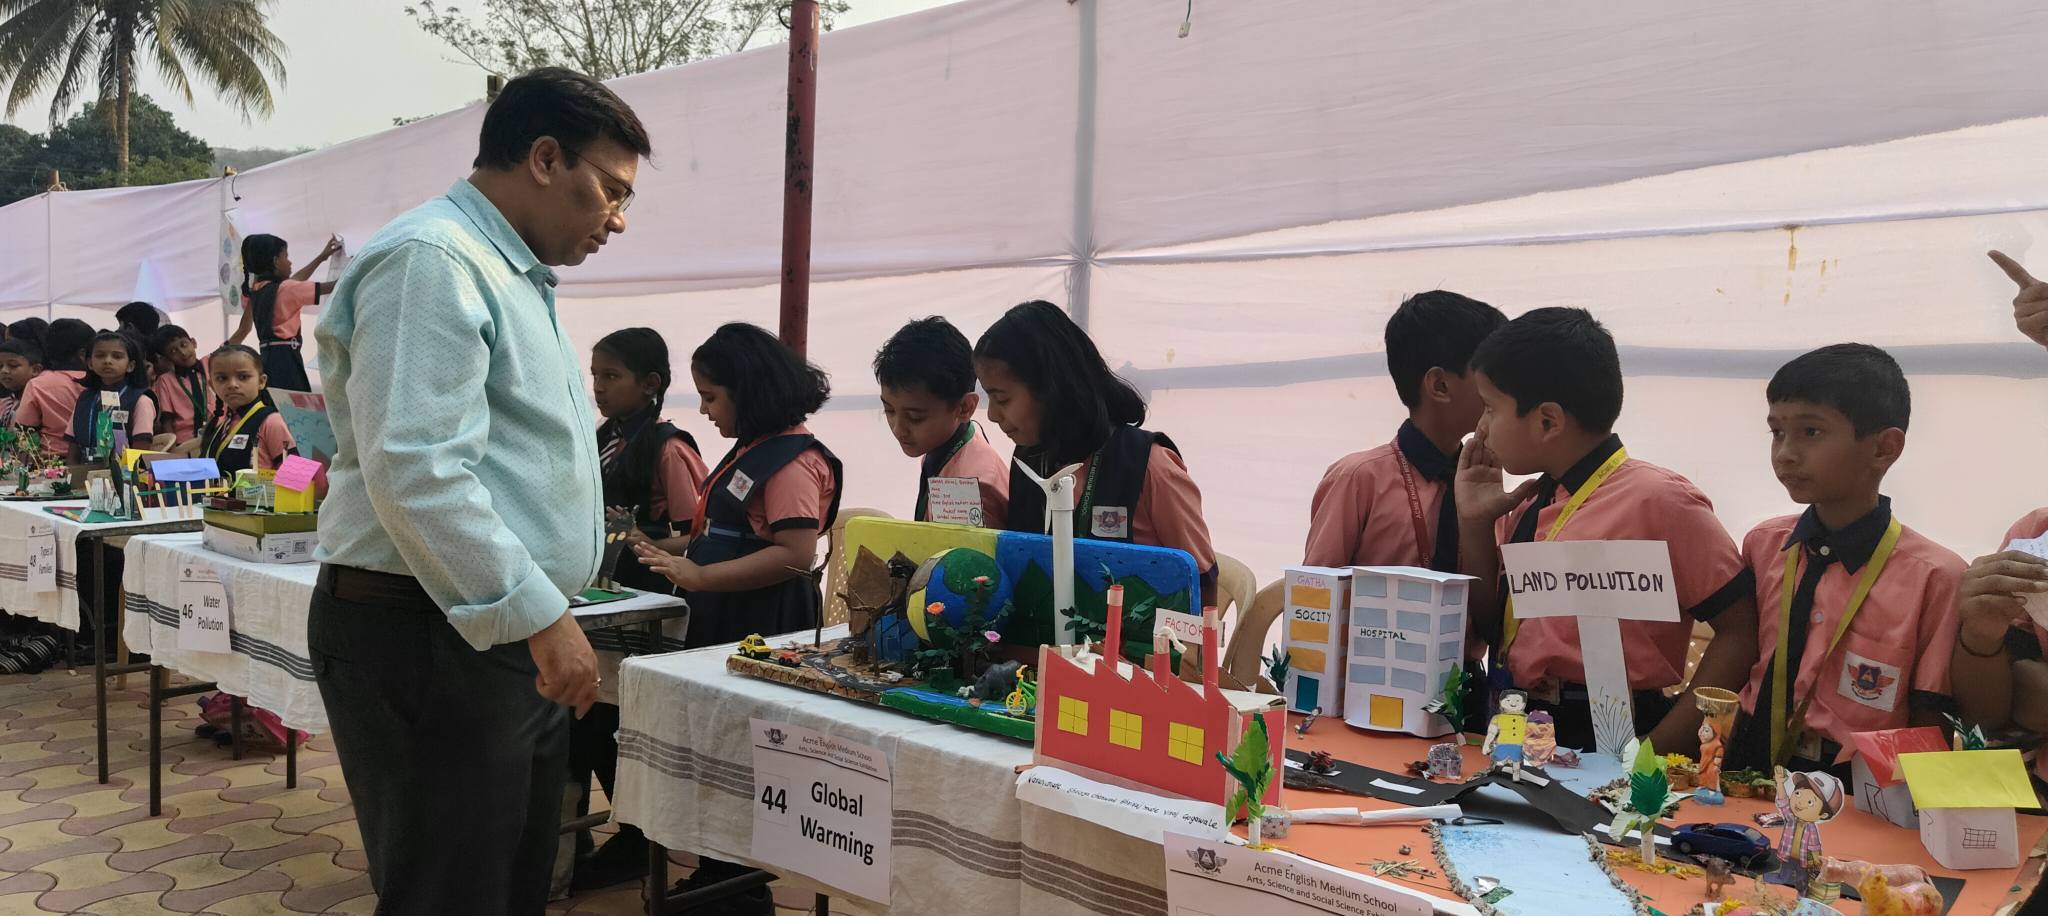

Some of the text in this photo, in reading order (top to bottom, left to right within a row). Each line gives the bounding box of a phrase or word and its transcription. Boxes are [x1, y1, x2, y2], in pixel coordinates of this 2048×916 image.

[1510, 571, 1663, 594] LAND POLLUTION
[182, 604, 193, 619] 46
[203, 595, 220, 608] Water
[197, 617, 224, 631] Pollution
[1295, 609, 1332, 623] SOCITY
[1165, 617, 1203, 637] FACTOR
[1360, 627, 1407, 641] HOSPITAL
[761, 785, 787, 814] 44
[811, 781, 863, 817] Global
[800, 814, 874, 866] Warming
[1247, 875, 1265, 887] Arts,
[1267, 879, 1294, 894] Science
[1296, 888, 1311, 899] and
[1312, 893, 1334, 906] Social
[1336, 900, 1365, 916] Science
[1254, 862, 1397, 913] Acme English Medium School
